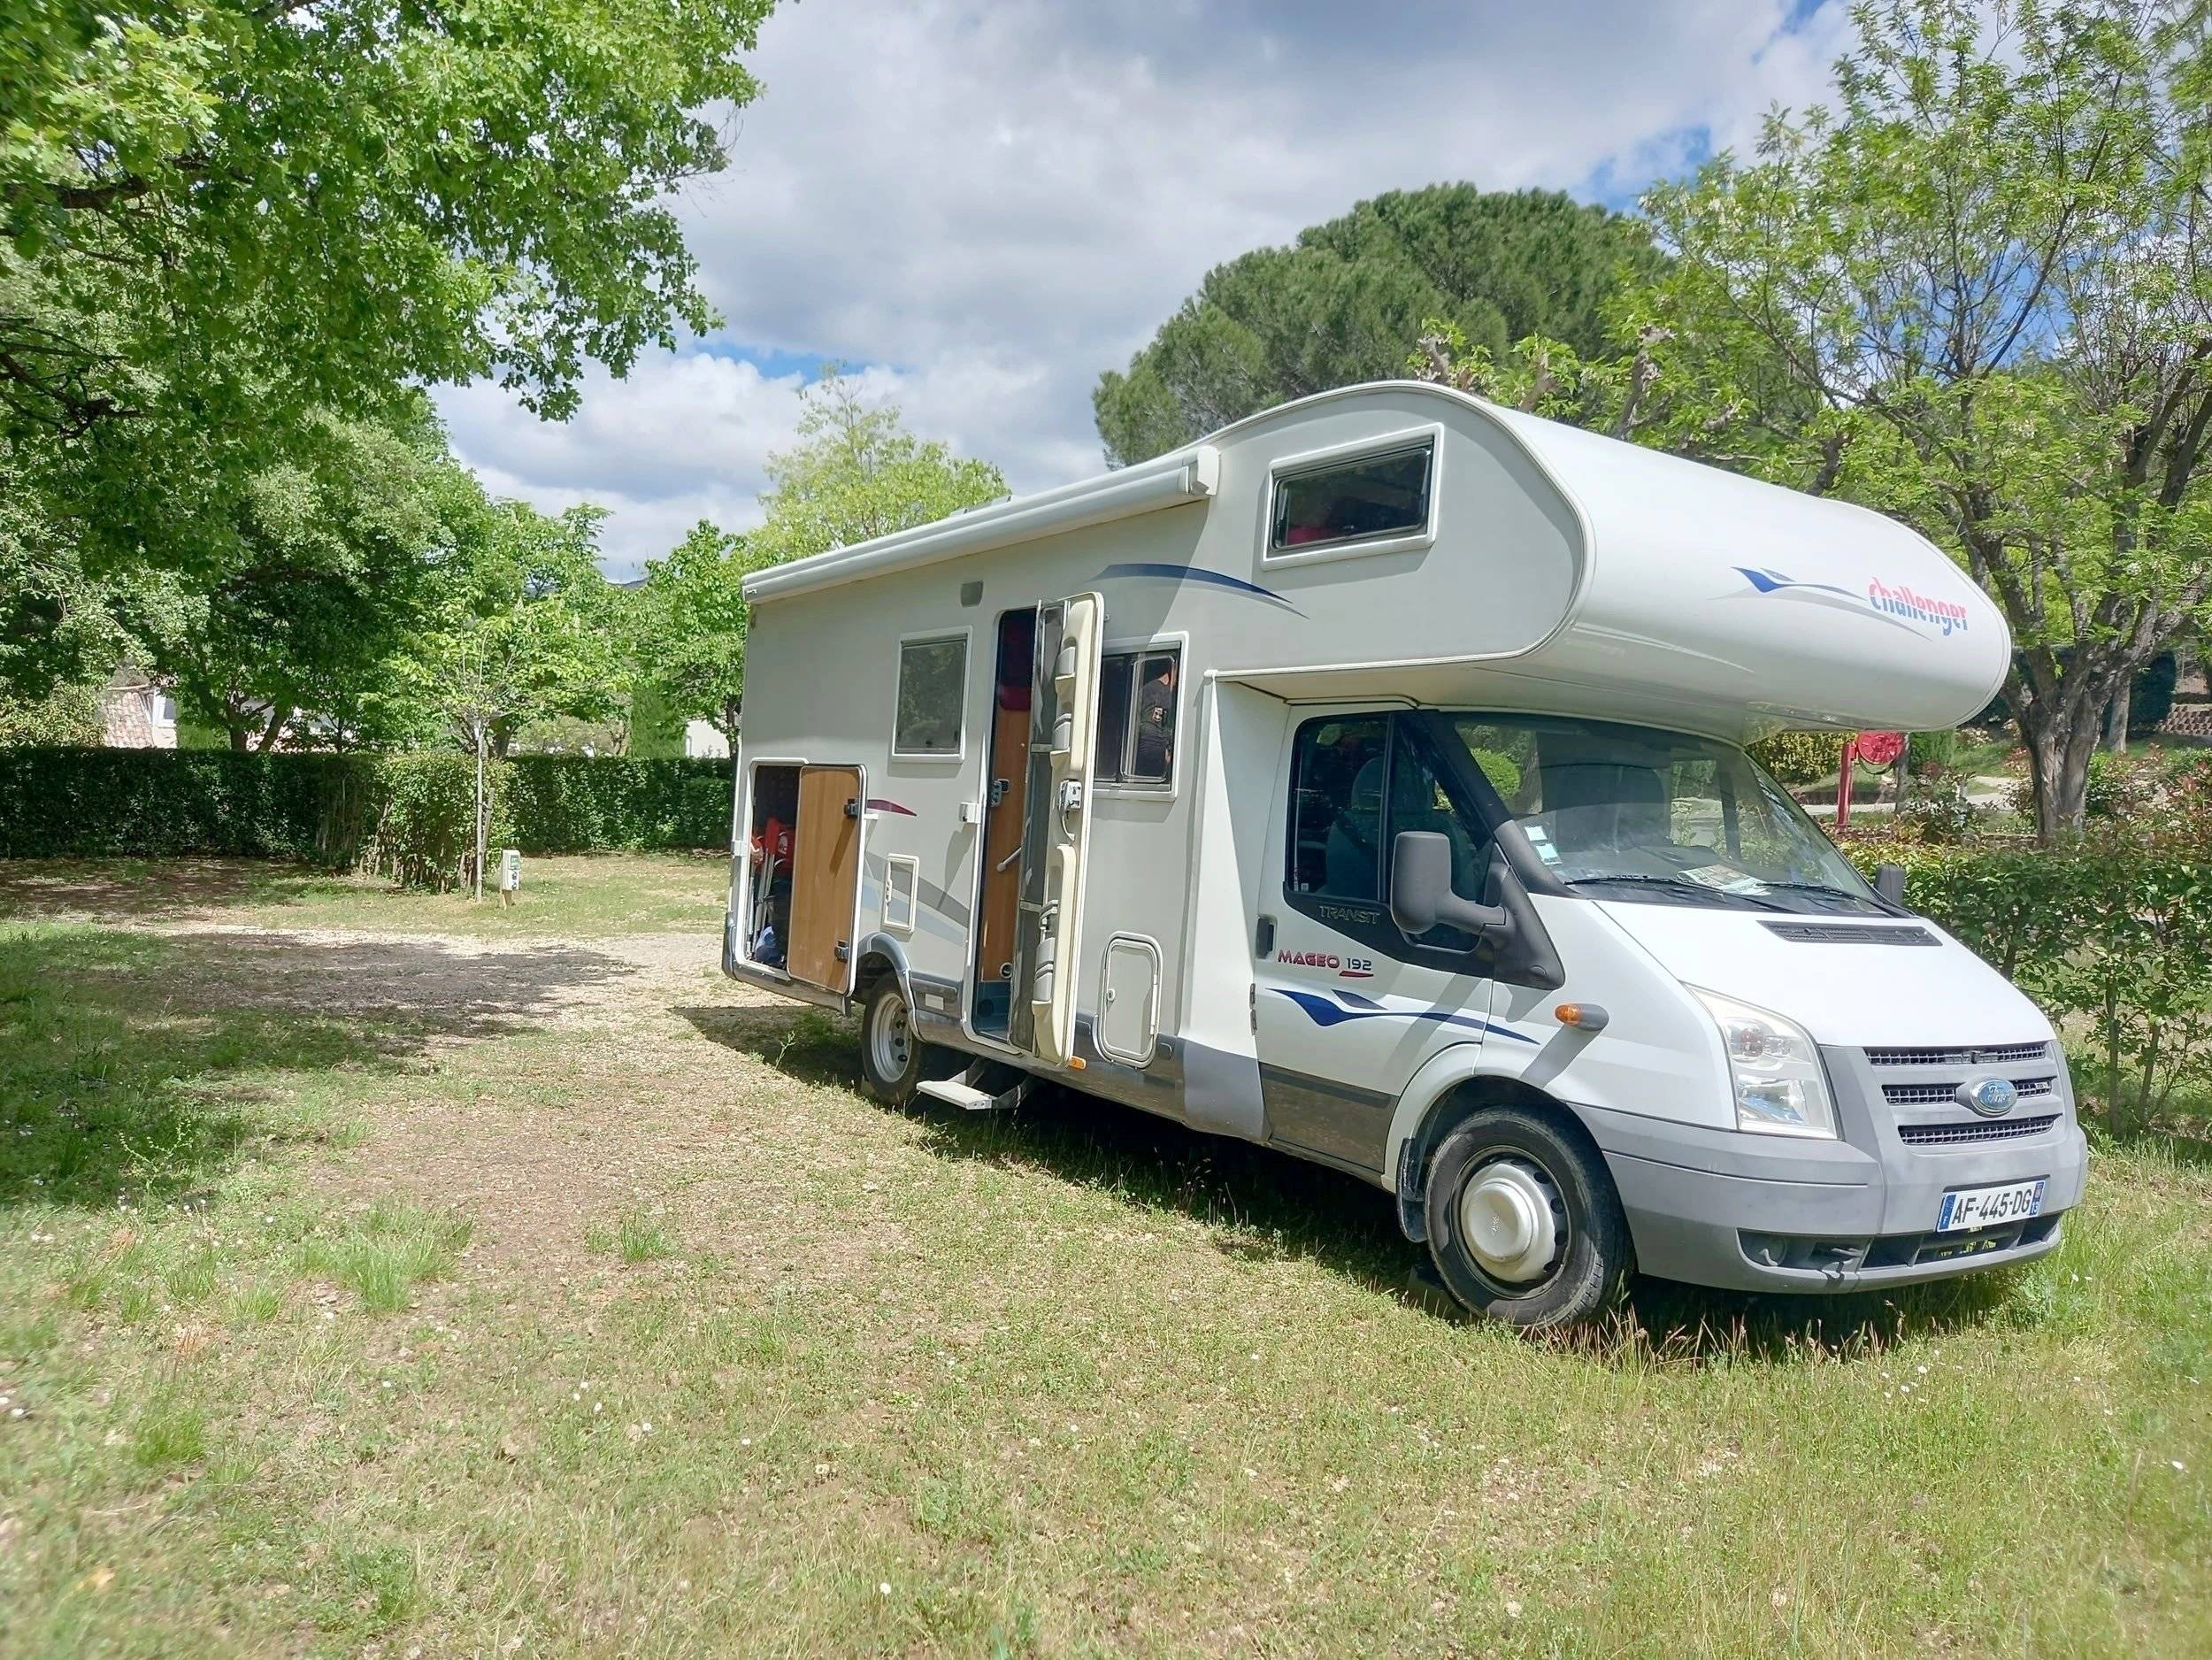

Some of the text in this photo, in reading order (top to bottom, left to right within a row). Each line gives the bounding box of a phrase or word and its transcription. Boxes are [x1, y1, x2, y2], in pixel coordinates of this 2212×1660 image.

[1319, 905, 1380, 925] TRANSIT
[1278, 949, 1372, 971] MAGEO 192
[1952, 1188, 2032, 1224] AF-445-DG
